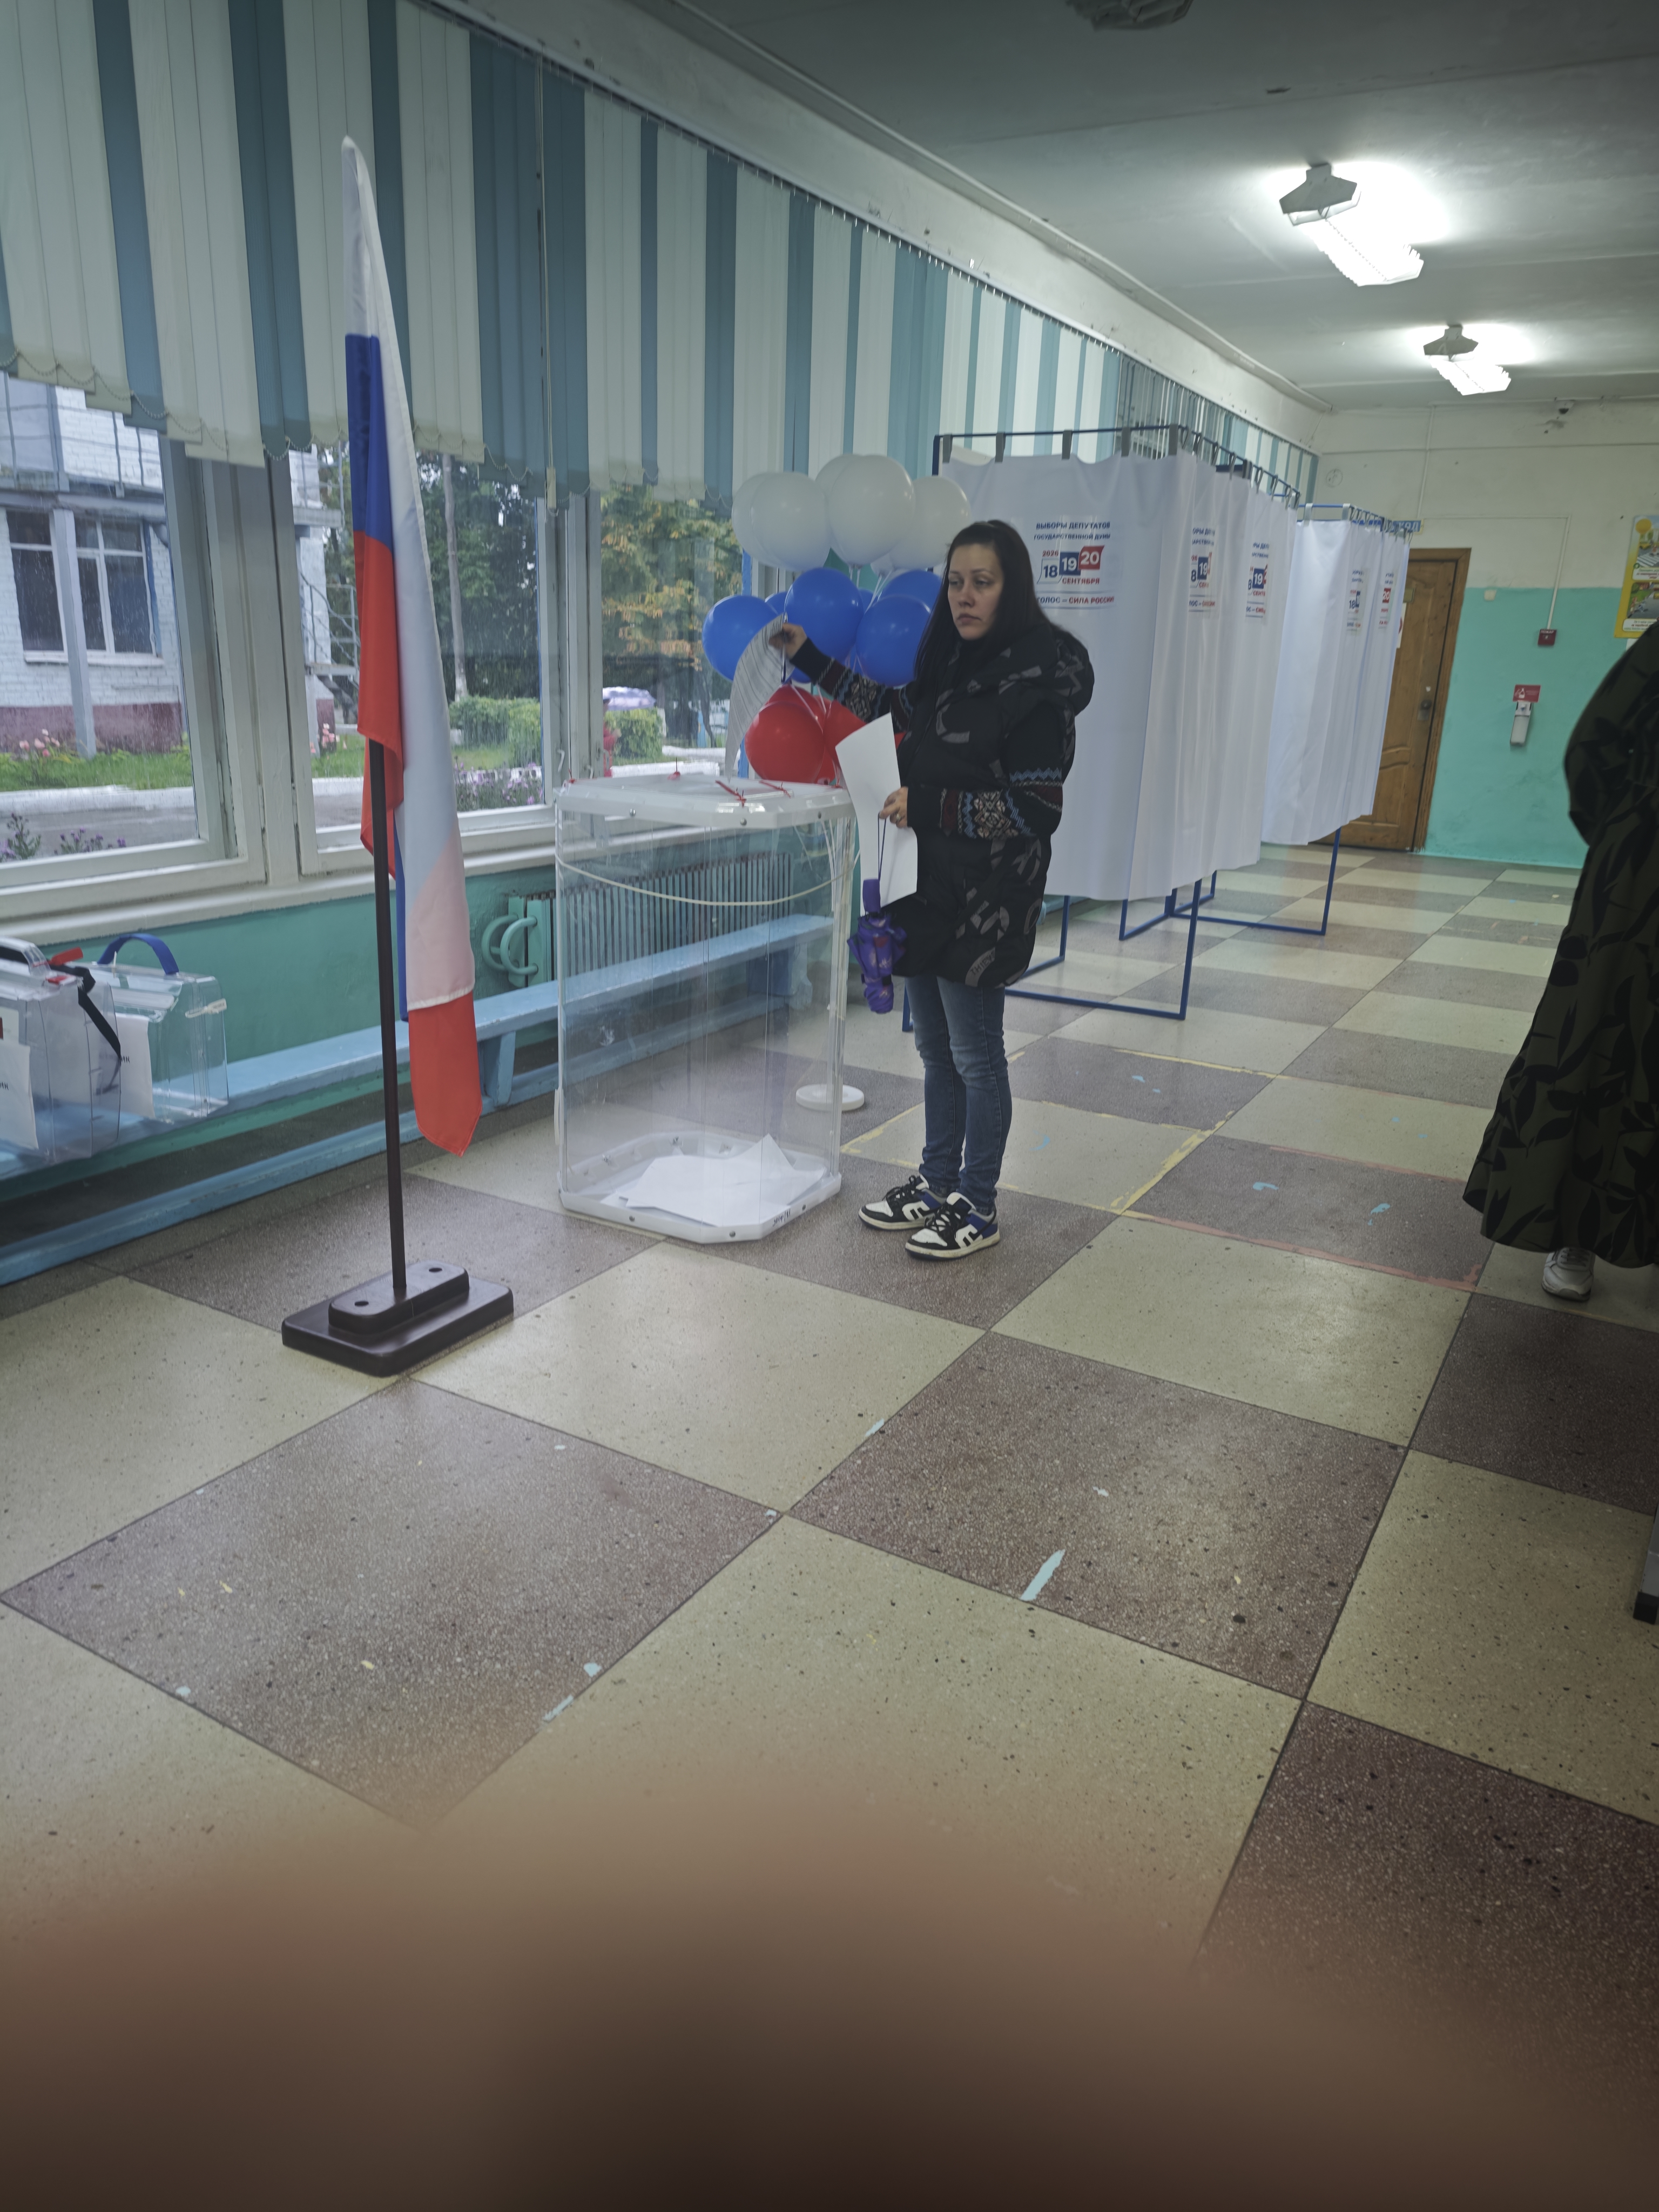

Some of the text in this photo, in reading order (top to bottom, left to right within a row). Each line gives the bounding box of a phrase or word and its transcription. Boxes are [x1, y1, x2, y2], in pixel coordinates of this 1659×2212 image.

[1036, 521, 1110, 530] ВЫБОРЫ ДЕПУТАТОВ
[1034, 532, 1110, 541] ГОСУДАРСТВЕННОЙ ДУМЫ
[1043, 551, 1100, 578] 18 19 20
[1062, 577, 1100, 585] СЕНТЯБРЯ
[1254, 572, 1263, 585] 19
[1069, 596, 1089, 604] СИЛА
[1090, 595, 1115, 604] РОССИИ!
[1382, 591, 1390, 600] 20
[1349, 599, 1355, 609] 18
